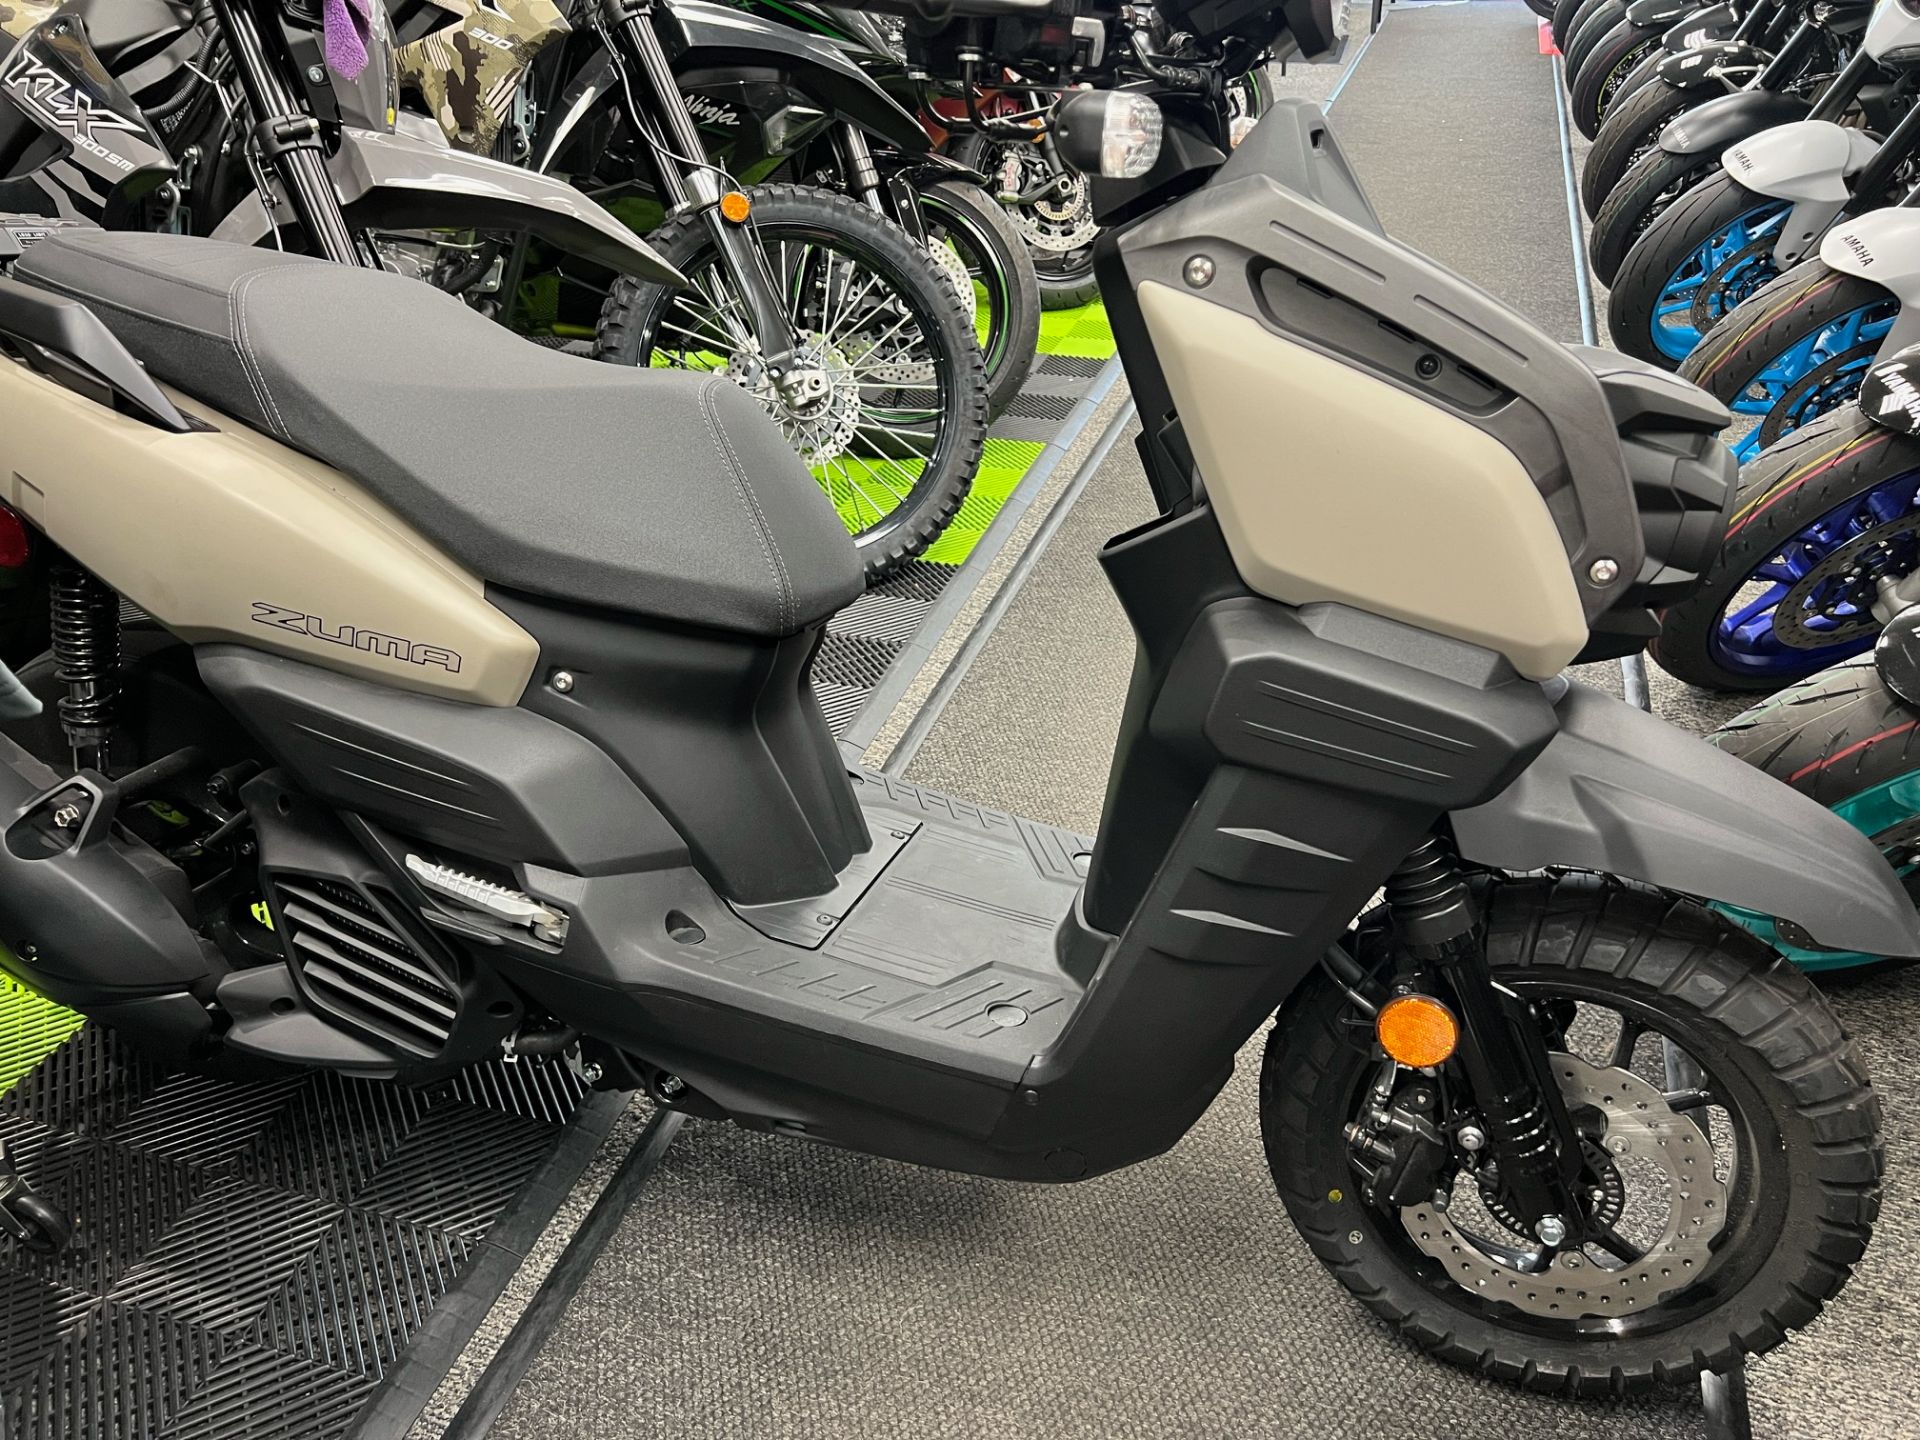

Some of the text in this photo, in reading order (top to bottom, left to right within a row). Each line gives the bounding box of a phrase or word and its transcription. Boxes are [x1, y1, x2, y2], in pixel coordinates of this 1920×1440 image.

[468, 26, 514, 50] 300
[4, 48, 147, 145] KLX
[684, 94, 740, 125] Ninja
[73, 133, 135, 172] 300SM
[251, 601, 462, 673] ZUMA
